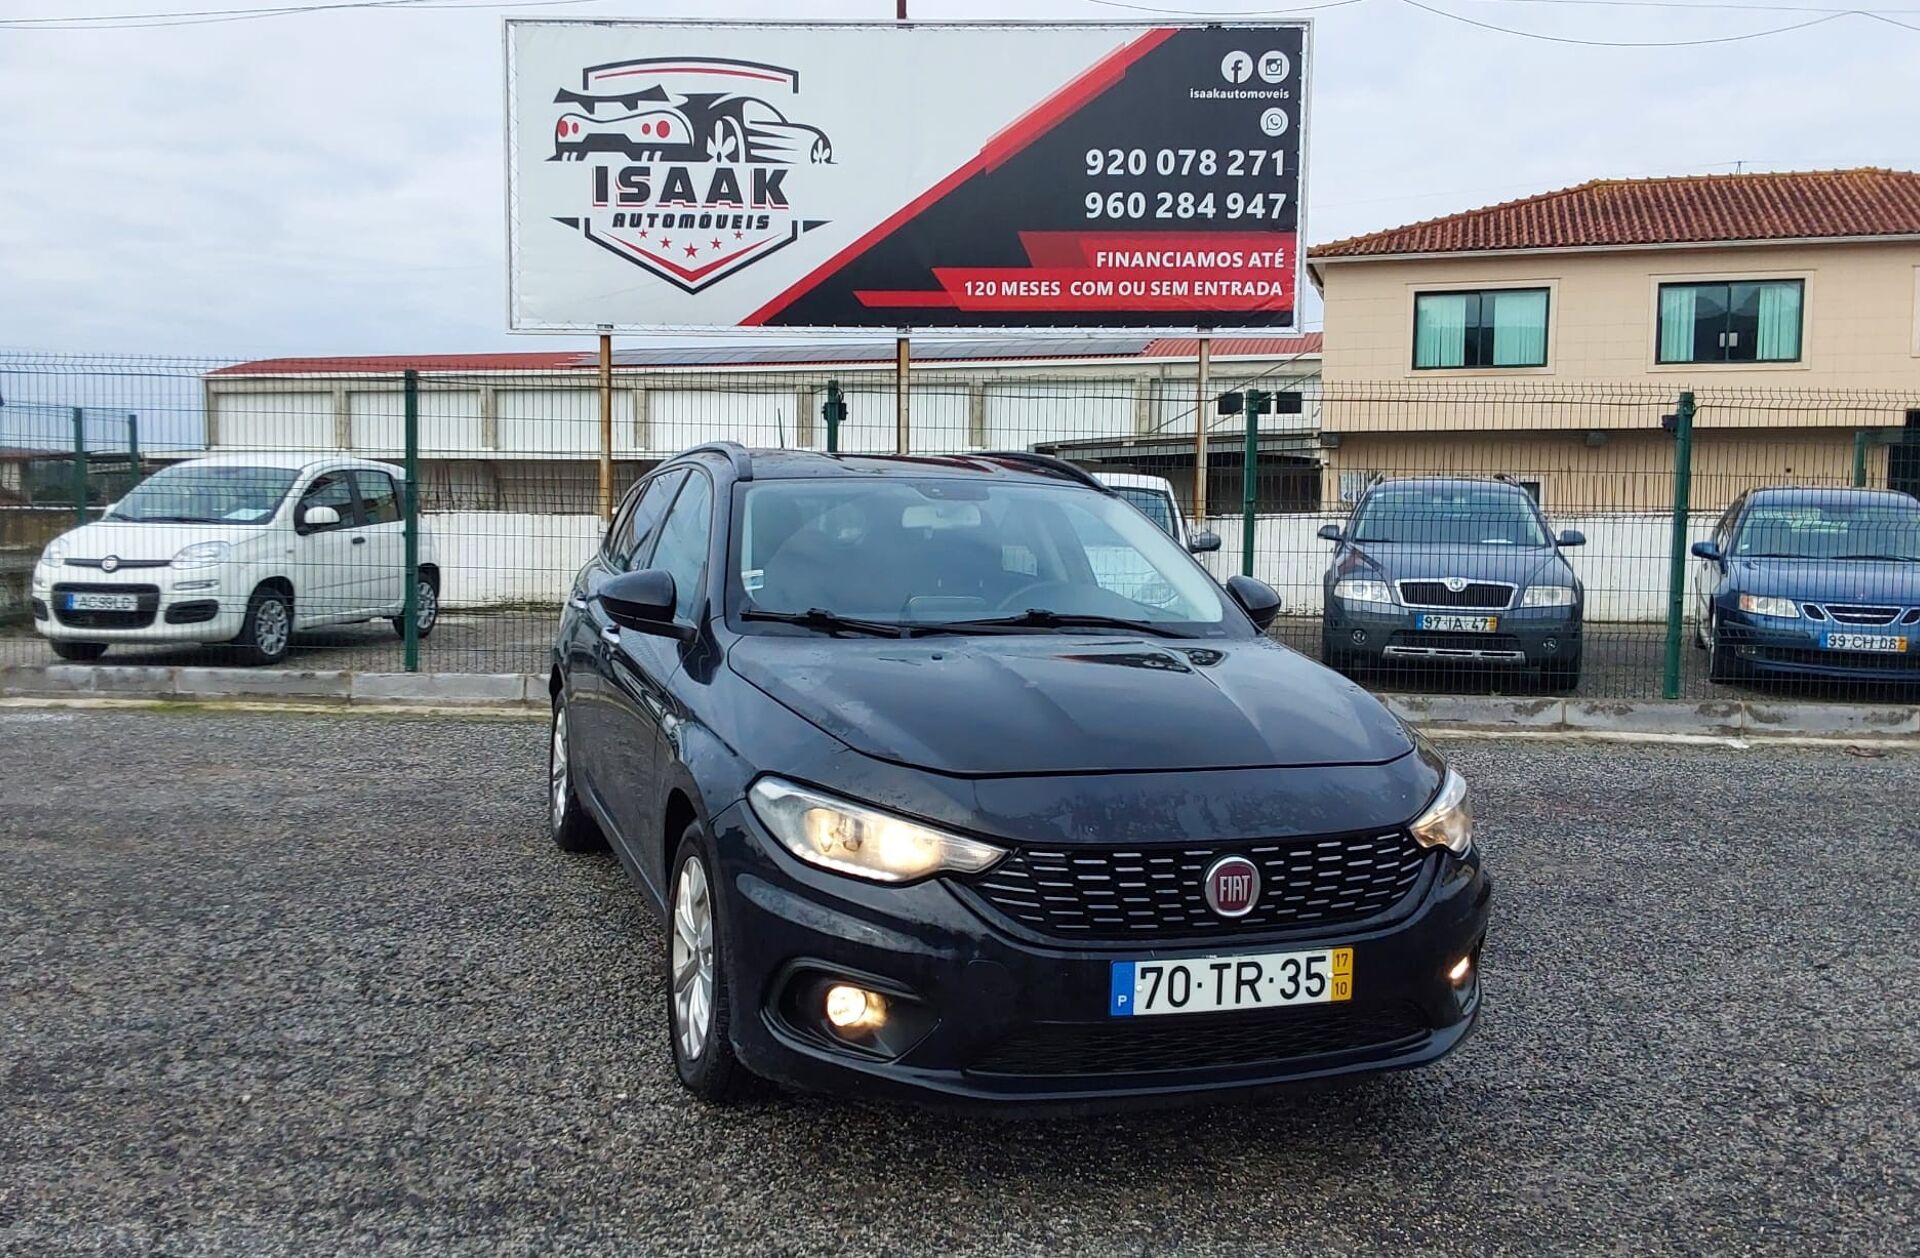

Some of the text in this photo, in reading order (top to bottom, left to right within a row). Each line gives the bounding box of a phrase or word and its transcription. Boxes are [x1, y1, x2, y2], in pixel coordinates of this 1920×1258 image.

[1189, 87, 1290, 99] isaakautomoveis
[1085, 148, 1285, 177] 920 078 271
[593, 165, 790, 209] ISAAK
[1084, 191, 1287, 220] 960 284 947
[1096, 248, 1285, 268] FINANCIAMOS ATÉ
[964, 280, 1283, 296] 120 MESES COM OU SEM ENTRADA
[1220, 875, 1250, 902] FIAT
[1336, 953, 1348, 967] 17
[1335, 982, 1348, 996] 10
[1117, 995, 1127, 1008] P
